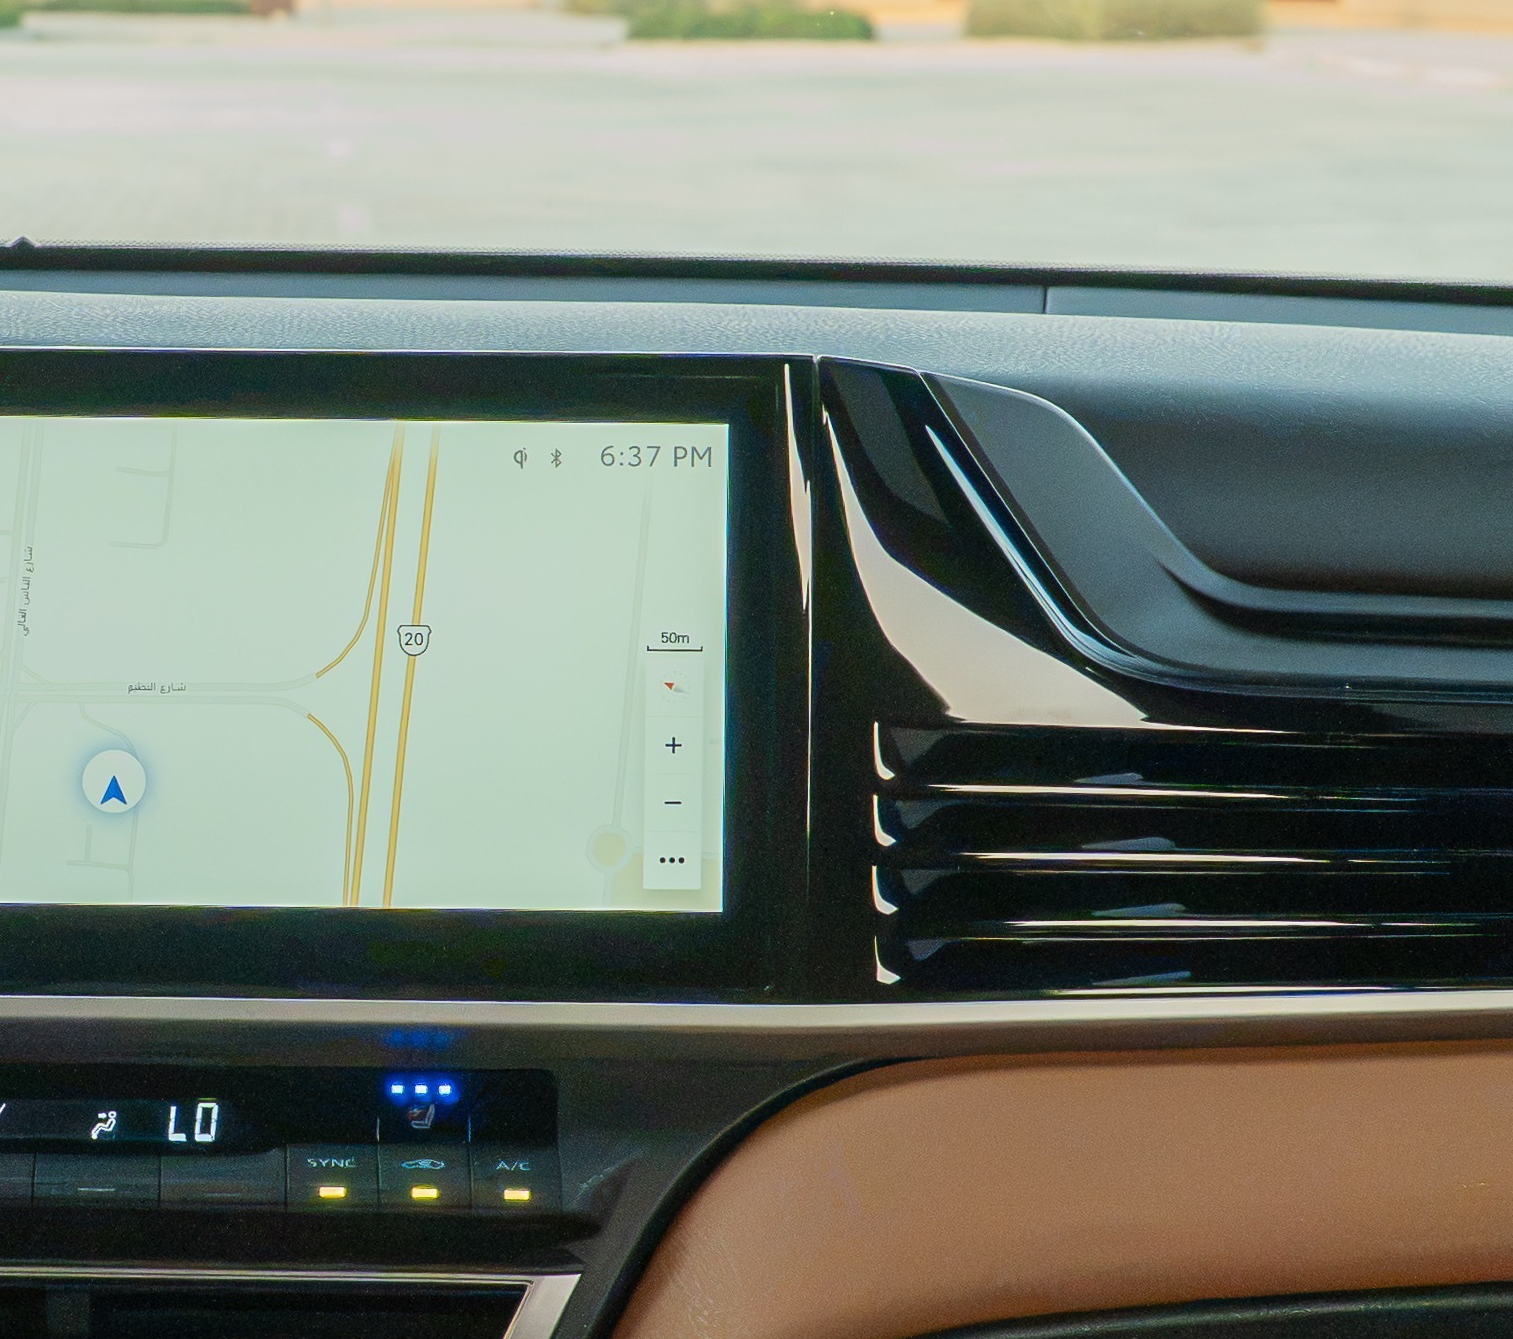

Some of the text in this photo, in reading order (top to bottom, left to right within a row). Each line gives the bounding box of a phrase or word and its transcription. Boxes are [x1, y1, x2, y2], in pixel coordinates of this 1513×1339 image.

[600, 445, 712, 467] 6:37 PM
[404, 632, 423, 646] 20
[661, 631, 689, 644] 50m
[307, 1158, 356, 1168] SYNC
[496, 1159, 531, 1171] A/C
